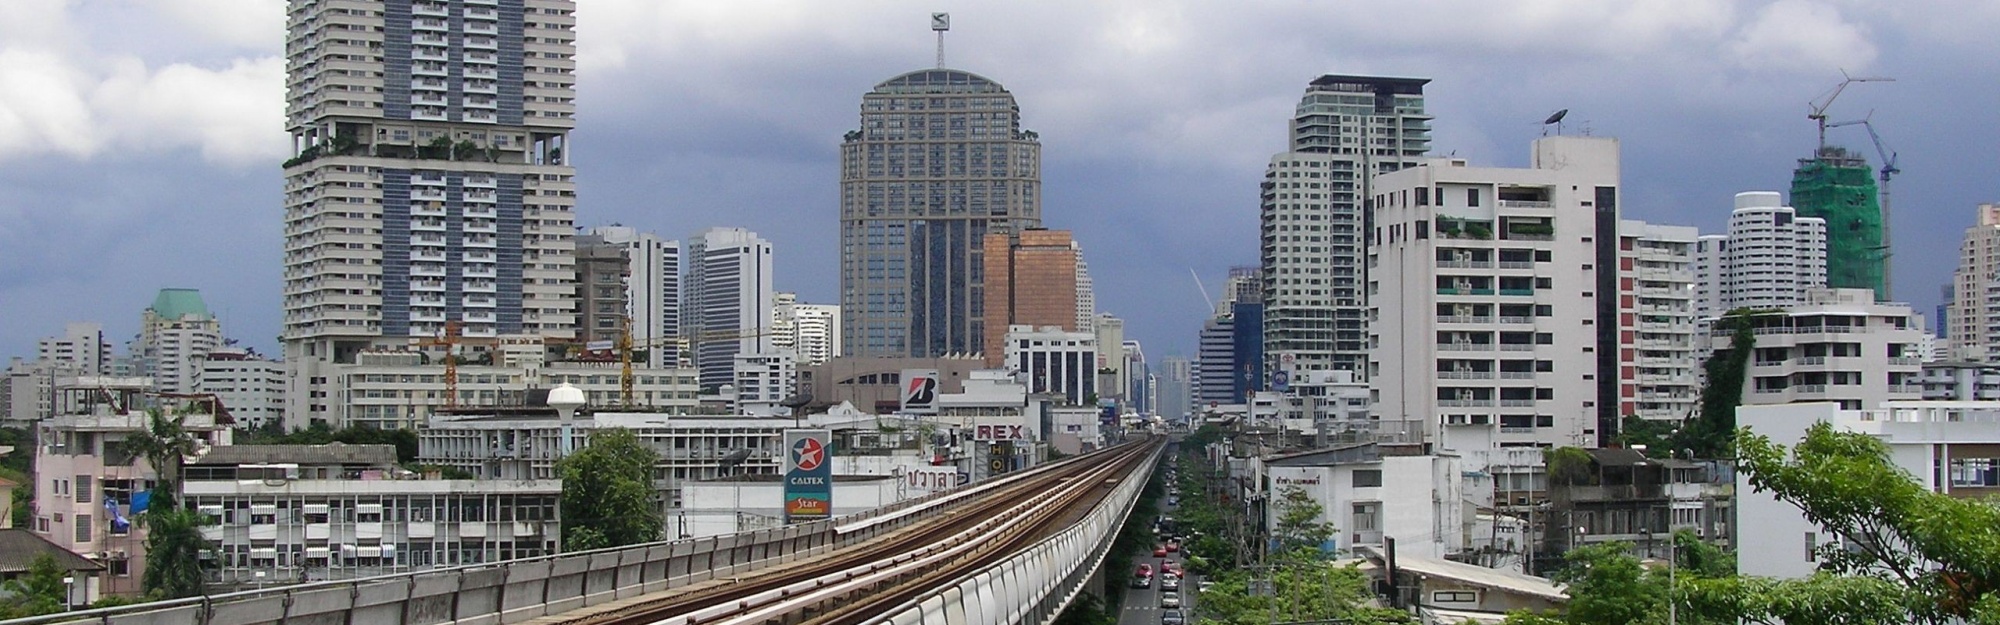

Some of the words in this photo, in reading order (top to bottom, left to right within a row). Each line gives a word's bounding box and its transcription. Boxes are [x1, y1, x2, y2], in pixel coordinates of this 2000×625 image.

[977, 425, 1022, 439] REX
[790, 477, 824, 485] CALTEX
[797, 497, 818, 509] Star
